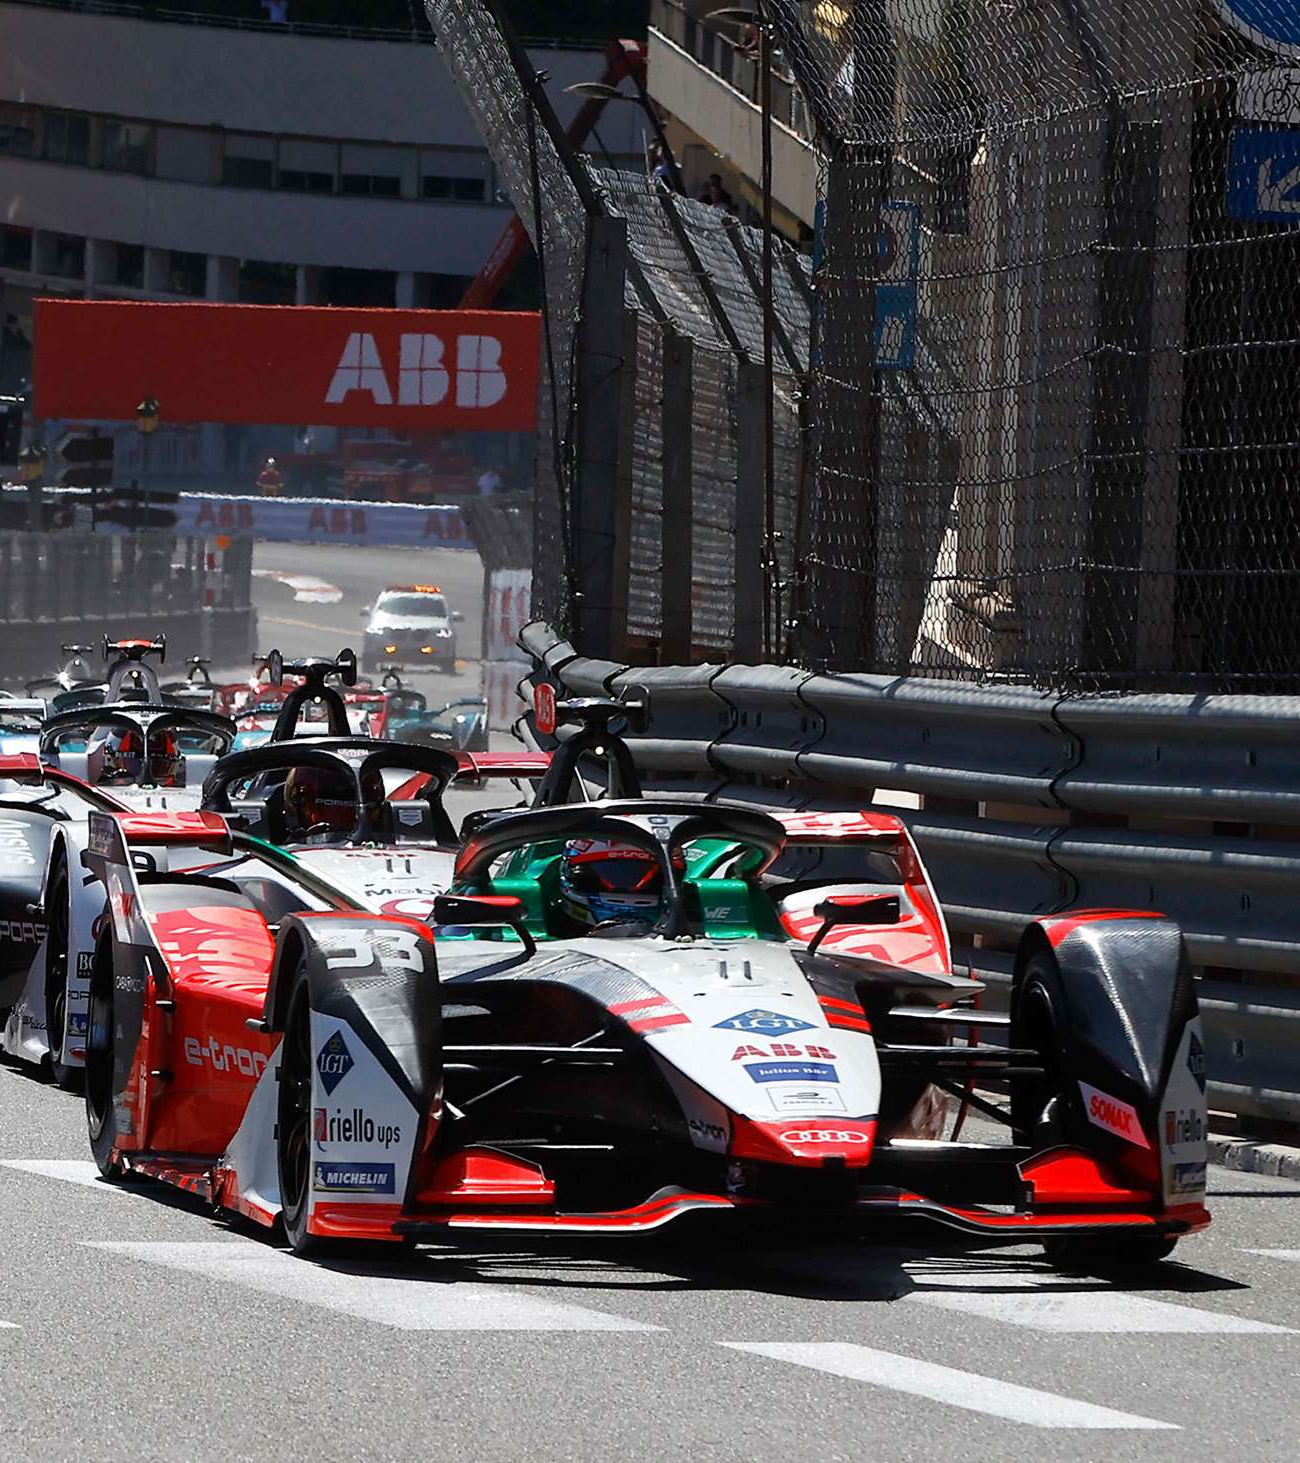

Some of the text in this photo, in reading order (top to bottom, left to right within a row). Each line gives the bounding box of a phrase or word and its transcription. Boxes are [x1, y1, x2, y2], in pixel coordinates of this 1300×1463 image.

[324, 332, 507, 408] ABB
[196, 502, 252, 528] ABB
[308, 507, 366, 534] ABB
[423, 511, 474, 541] AB
[732, 1019, 803, 1029] LGT
[320, 1054, 349, 1074] LGT
[732, 1044, 837, 1061] ABB
[1089, 1095, 1133, 1134] SONAX
[329, 1109, 401, 1149] riello ups
[326, 1171, 388, 1185] MICHELIN
